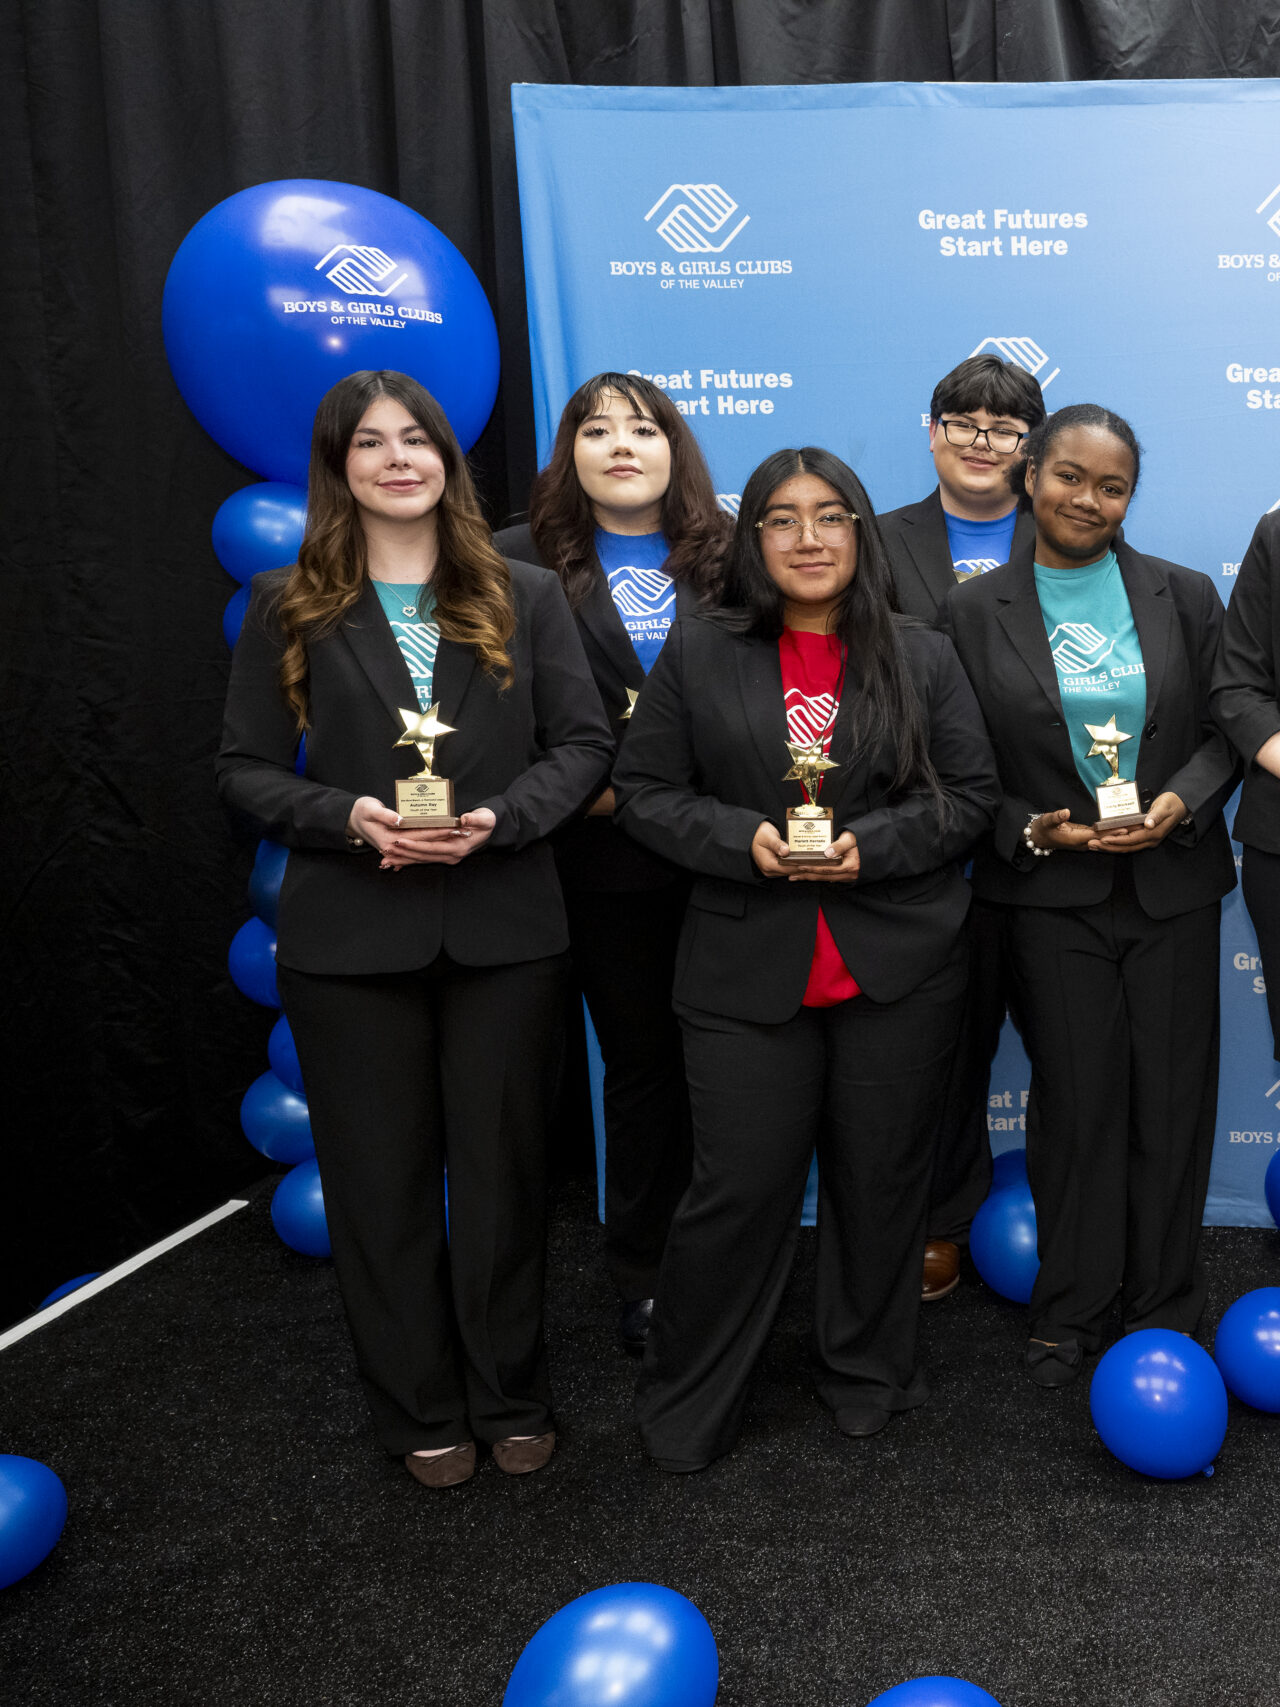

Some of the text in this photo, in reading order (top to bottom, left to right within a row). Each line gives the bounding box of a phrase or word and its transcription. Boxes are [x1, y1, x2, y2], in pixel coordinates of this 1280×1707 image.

[918, 209, 1088, 230] Great Futures
[940, 236, 1068, 256] Start Here
[610, 260, 793, 275] BOYS & GIRLS CLUBS
[1218, 254, 1264, 269] BOYS
[660, 279, 744, 289] OF THE VALLEY
[283, 301, 443, 324] BOYS & GIRLS CLUBS
[331, 316, 406, 329] OF THE VALLEY
[700, 369, 793, 389] Futures
[673, 396, 774, 415] art Here
[1222, 562, 1241, 576] BO
[625, 618, 671, 631] GIRLS
[645, 631, 668, 640] VAL
[1063, 663, 1145, 686] GIRLS CLU
[1084, 681, 1120, 692] VALLEY
[987, 1114, 1025, 1130] tart
[1229, 1131, 1272, 1144] BOYS
